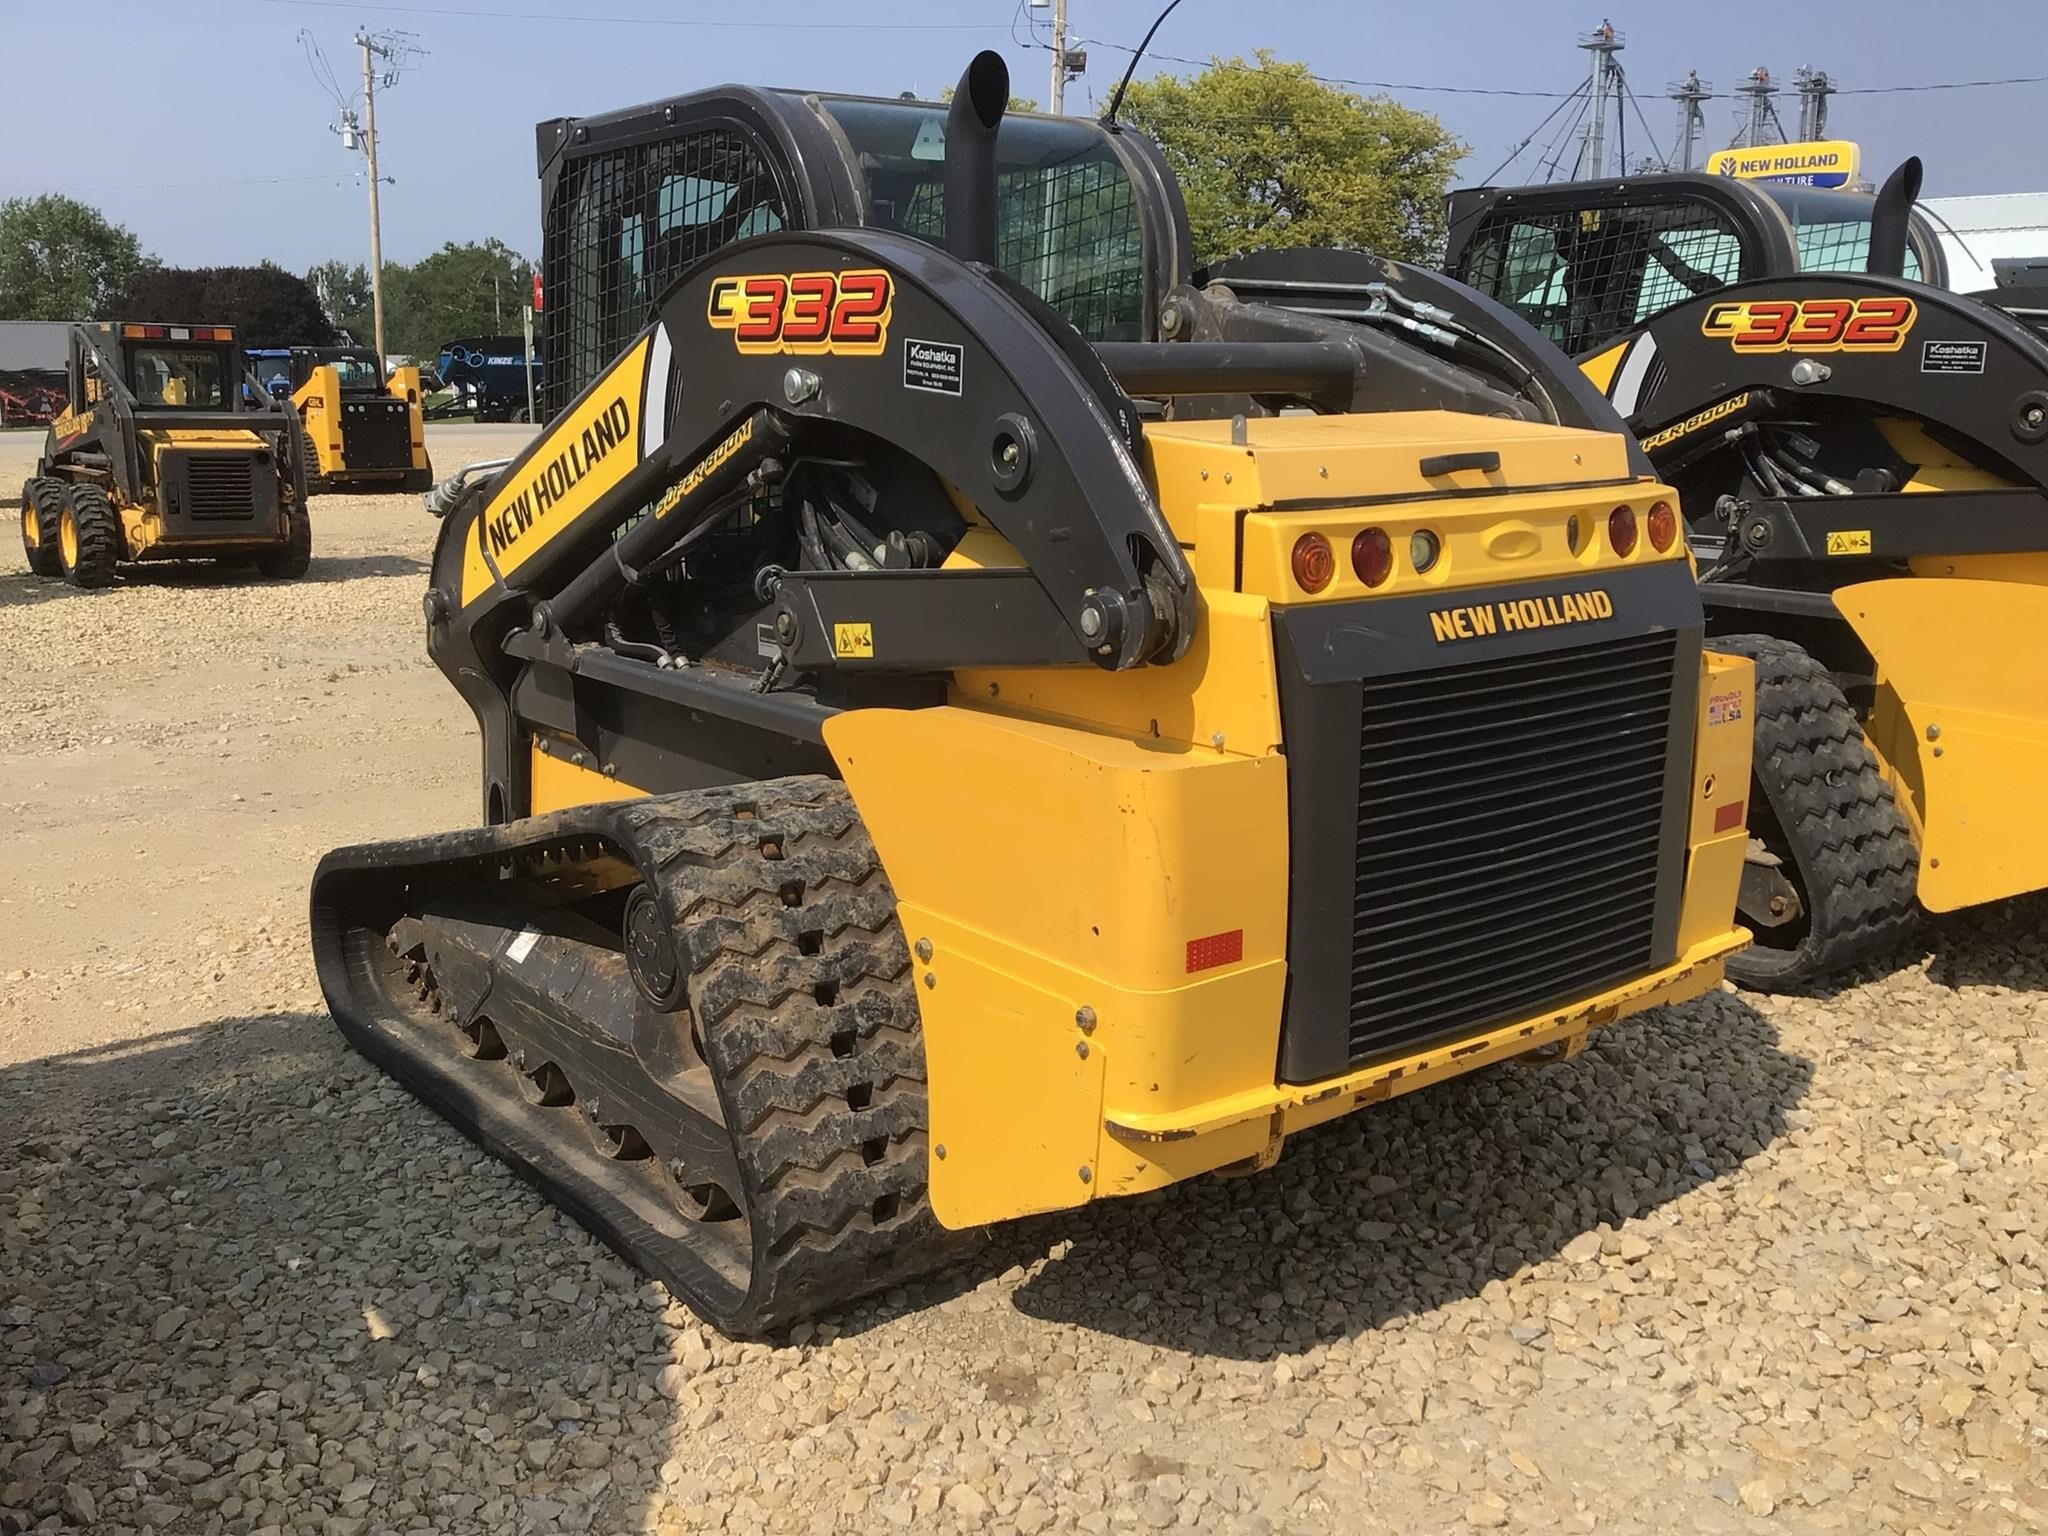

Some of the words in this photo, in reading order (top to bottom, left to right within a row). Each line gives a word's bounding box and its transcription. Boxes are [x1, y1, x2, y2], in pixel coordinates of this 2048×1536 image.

[1740, 159, 1771, 173] NEW
[1774, 153, 1838, 170] HOLLAND
[487, 356, 514, 365] KINZE
[910, 344, 956, 364] Koshatka
[1930, 344, 1978, 354] Koshatka
[1686, 392, 1749, 432] BOOM
[705, 416, 752, 476] BOOM
[488, 489, 533, 558] NEW
[532, 396, 631, 517] HOLLAND
[1430, 604, 1497, 642] NEW
[1499, 590, 1614, 632] HOLLAND
